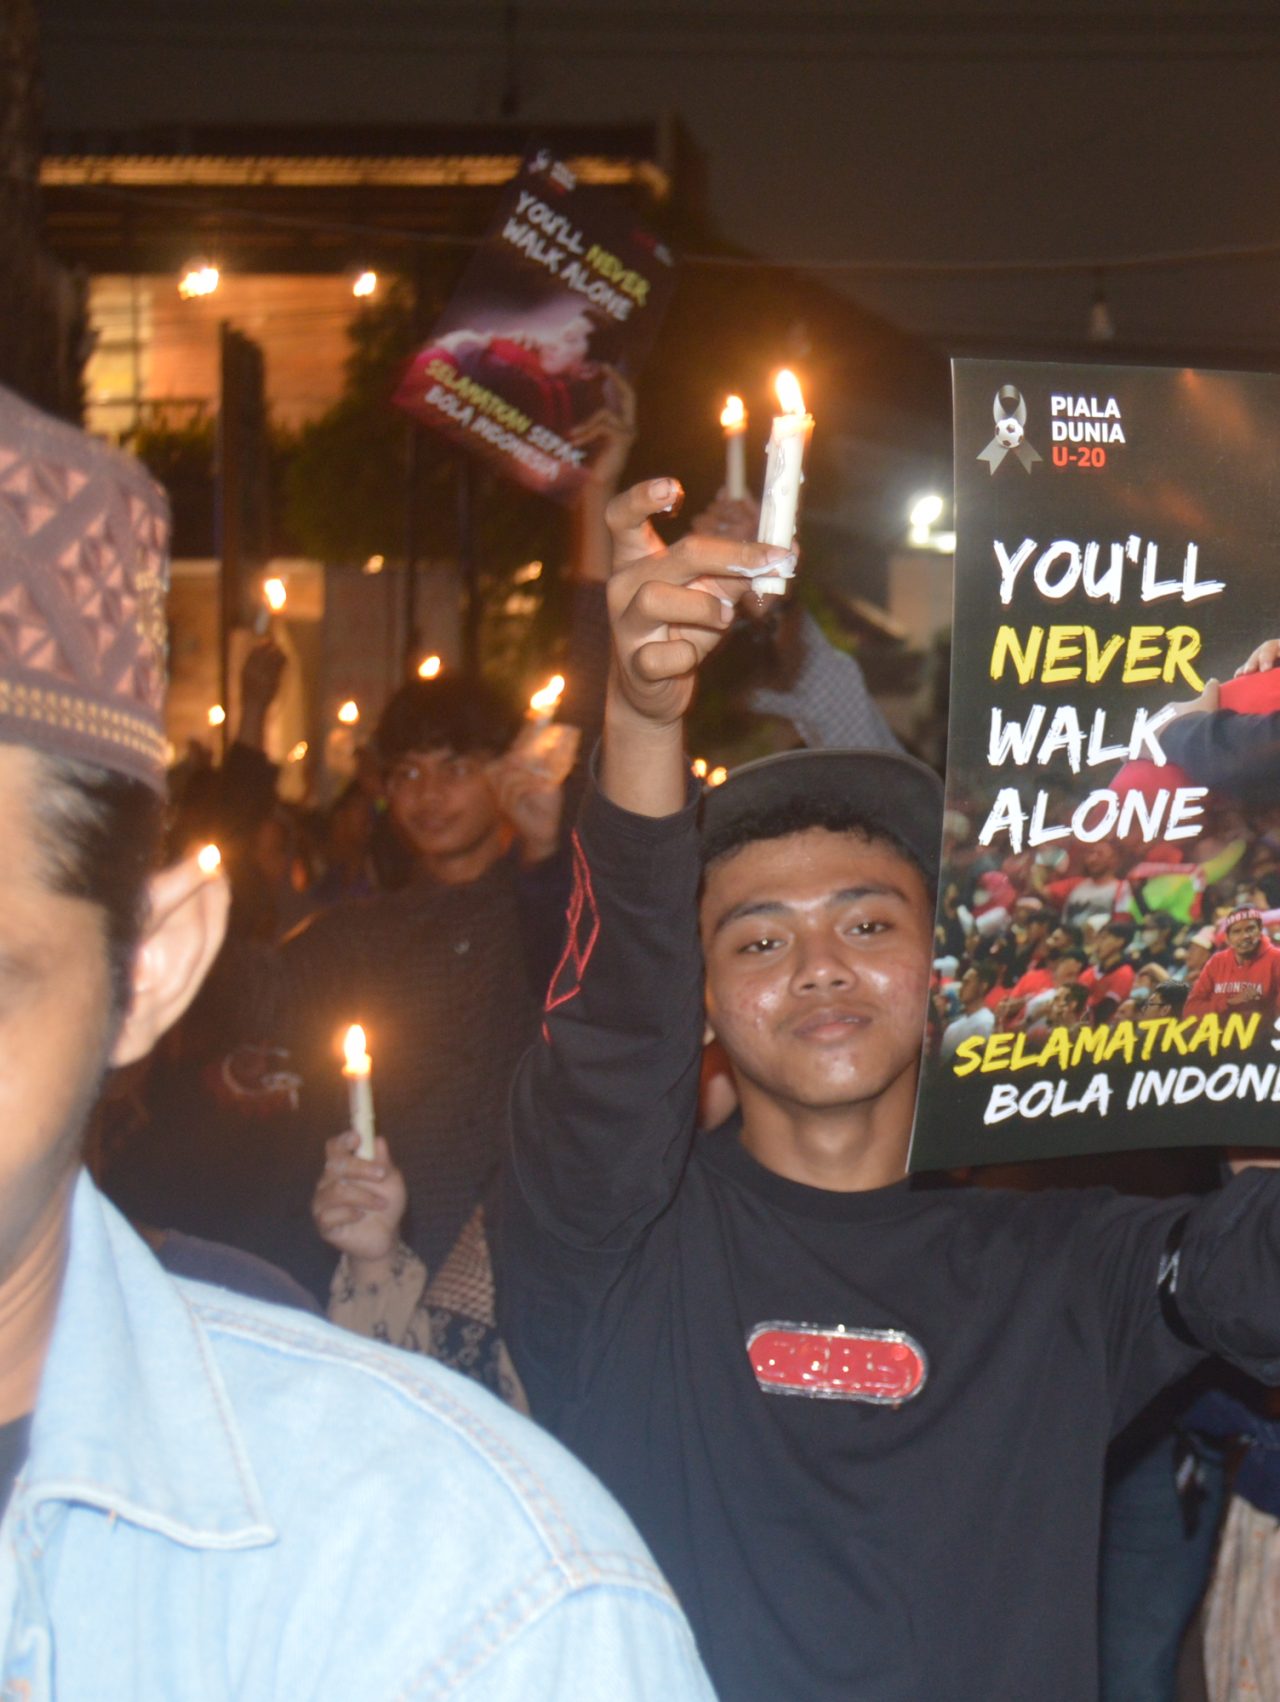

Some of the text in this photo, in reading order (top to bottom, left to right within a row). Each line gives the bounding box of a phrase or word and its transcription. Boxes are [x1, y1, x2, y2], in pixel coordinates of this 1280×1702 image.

[502, 217, 634, 321] WALK ALONE
[514, 191, 584, 255] YOU'LL
[586, 245, 651, 306] NEVER
[425, 384, 475, 427] BOLA
[1050, 396, 1121, 419] PIALA
[1051, 420, 1126, 444] DUNIA
[1052, 445, 1107, 468] U-20
[993, 534, 1226, 605] YOU'LL
[990, 625, 1206, 693] NEVER
[986, 701, 1178, 775] WALK
[978, 787, 1208, 855] ALONE
[953, 1012, 1261, 1077] SELAMATKAN
[983, 1073, 1113, 1125] BOLA
